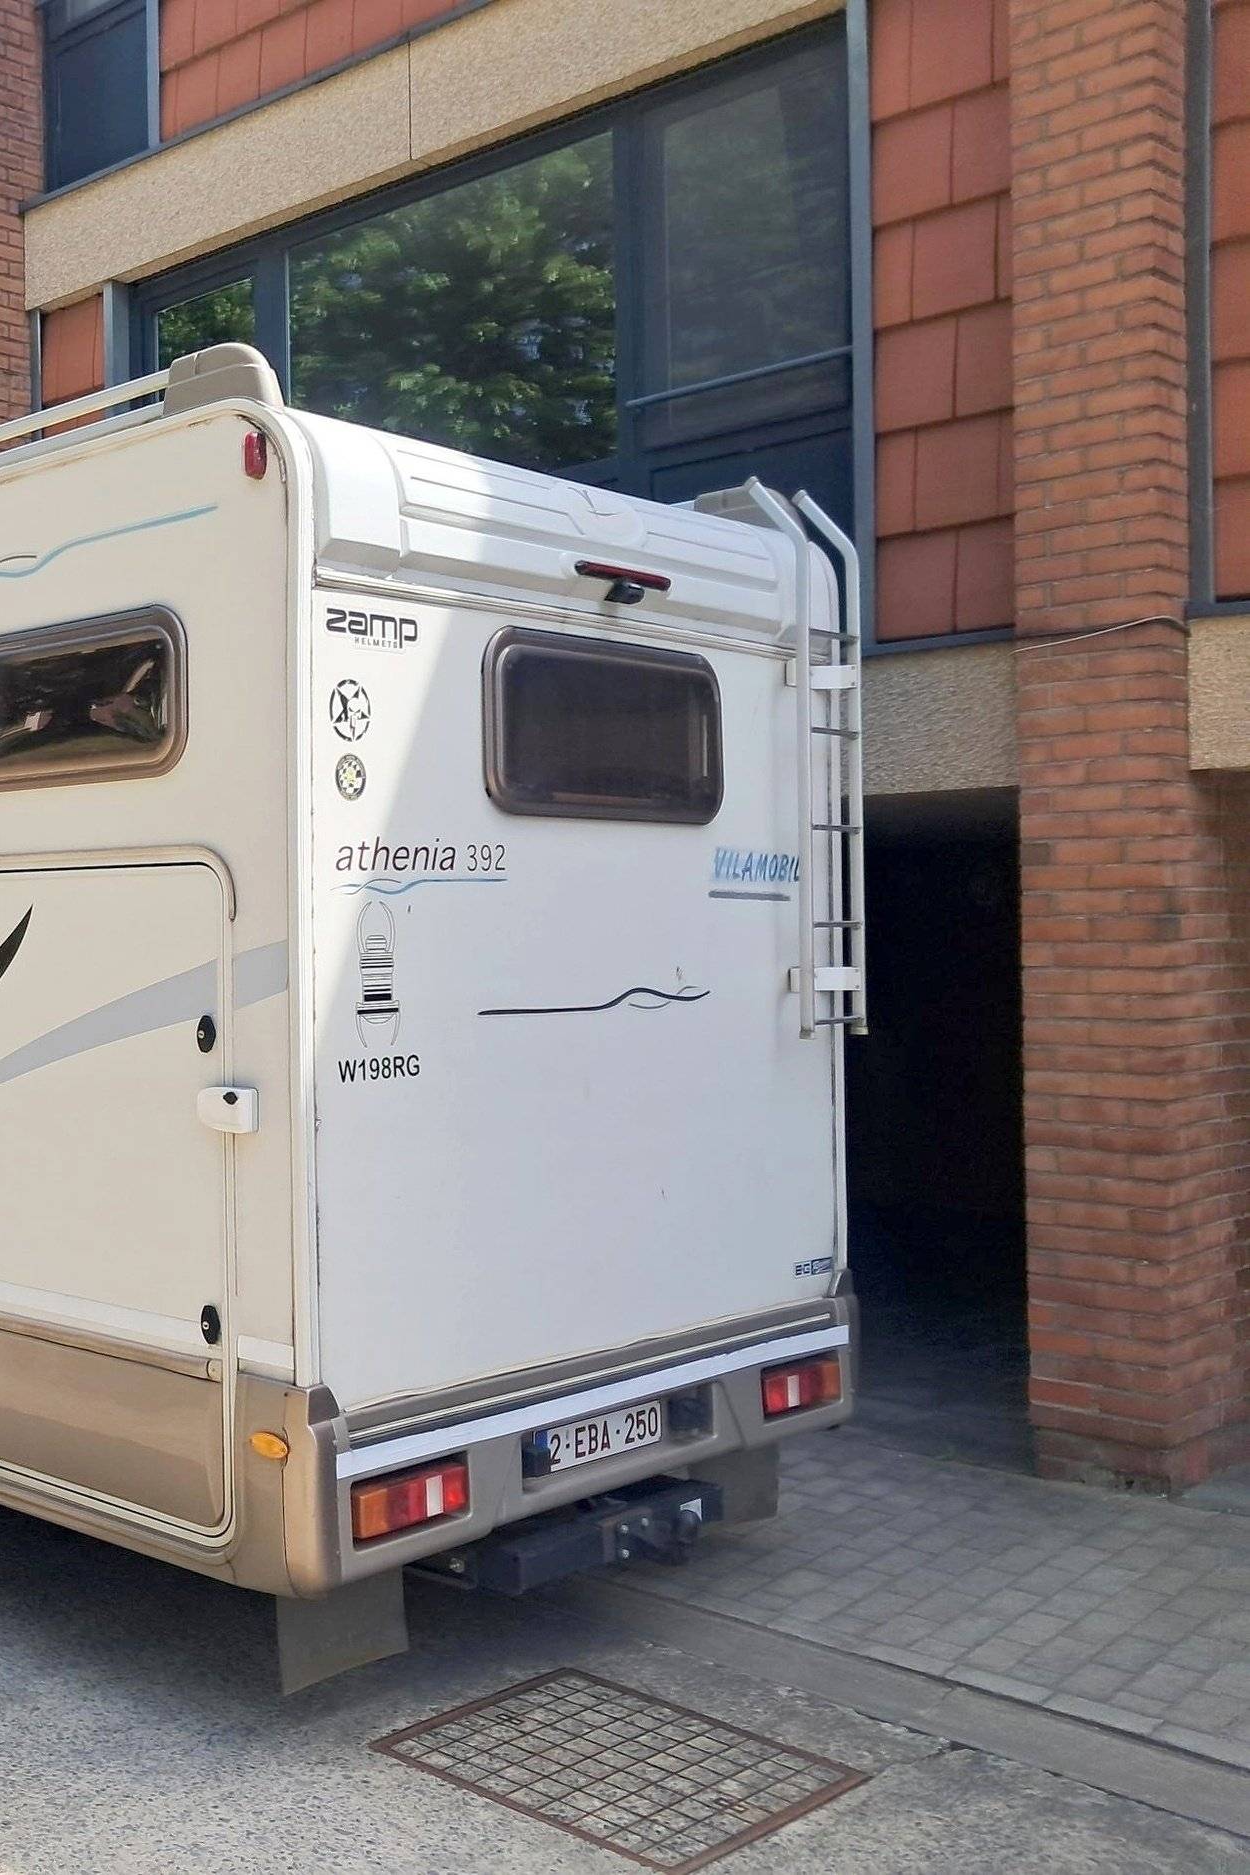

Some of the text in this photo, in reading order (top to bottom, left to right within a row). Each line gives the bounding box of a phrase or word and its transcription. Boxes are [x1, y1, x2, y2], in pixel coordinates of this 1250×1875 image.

[354, 636, 398, 649] HELMETS
[335, 836, 506, 872] athenia 392
[338, 1054, 420, 1083] W198RG
